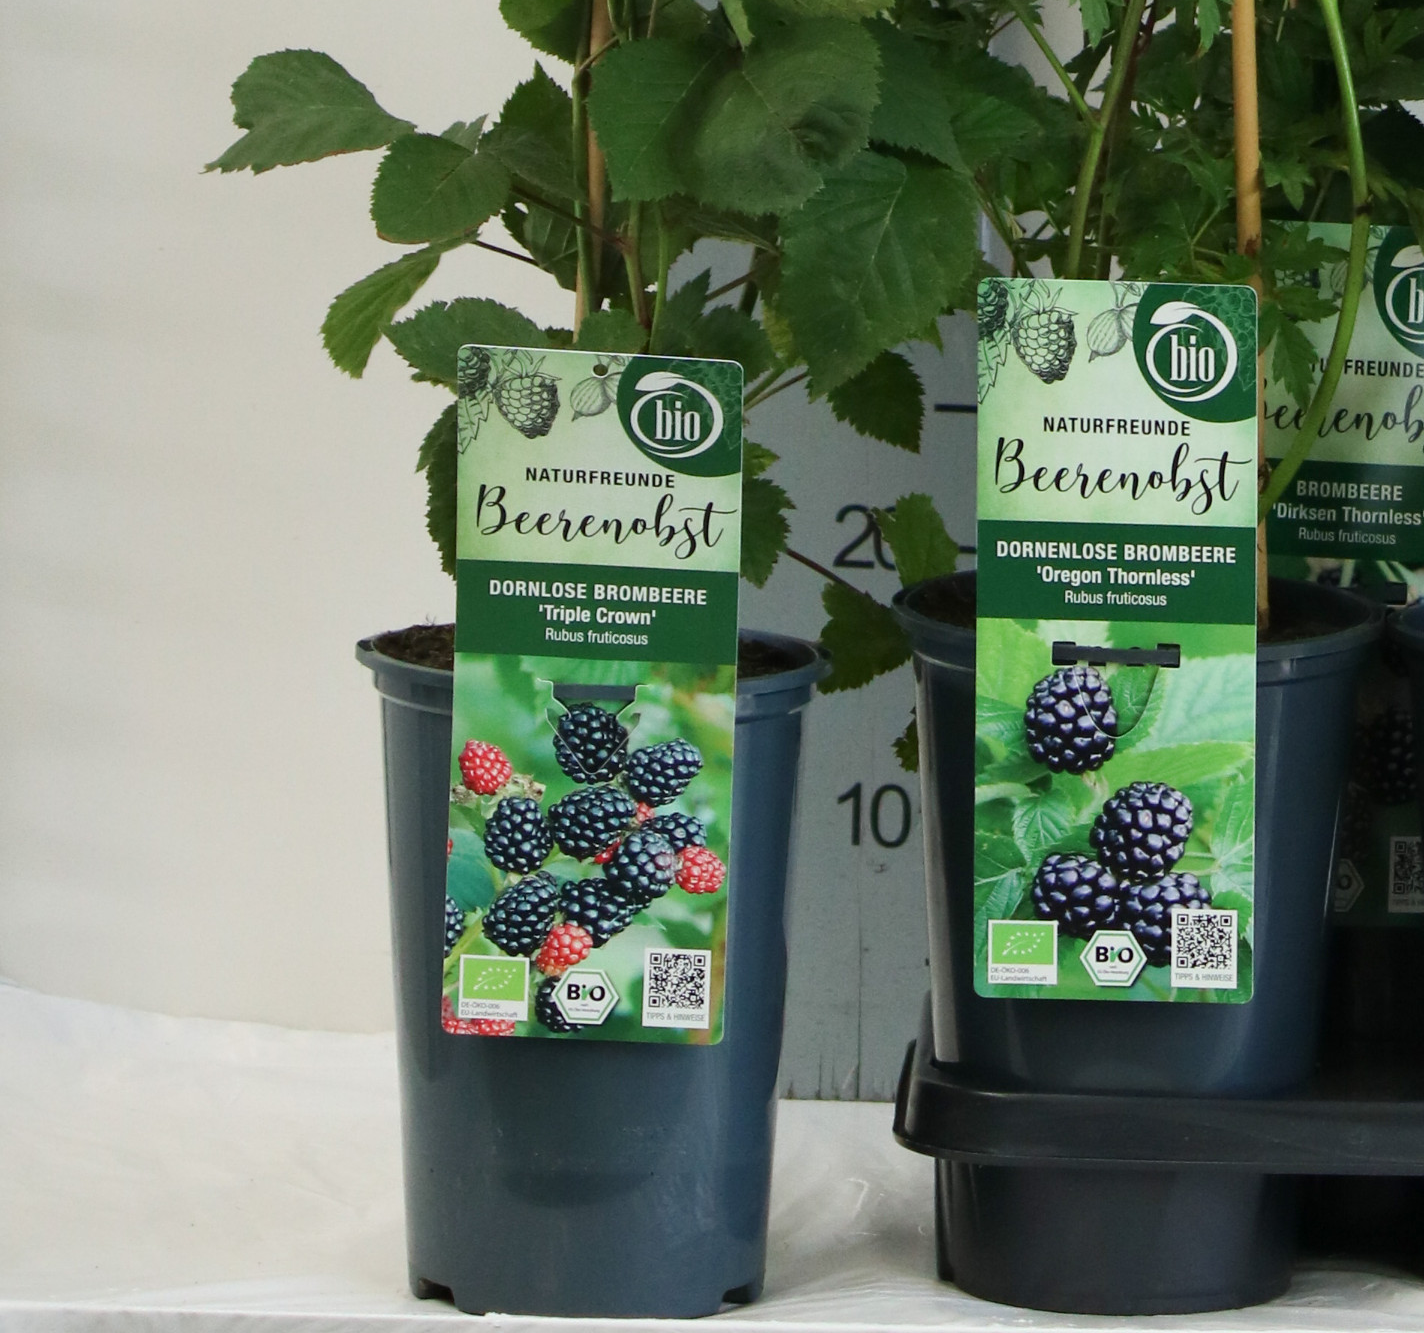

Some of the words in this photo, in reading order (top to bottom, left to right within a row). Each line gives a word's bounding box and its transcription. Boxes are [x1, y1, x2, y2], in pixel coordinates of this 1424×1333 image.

[1170, 335, 1215, 382] bio
[655, 399, 700, 441] bio
[1043, 416, 1191, 437] NATURFREUNDE
[525, 467, 676, 489] NATURFREUNDE
[995, 437, 1252, 515] Beerenobst
[1297, 480, 1403, 501] BROMBEERE
[476, 484, 738, 559] Beerenobst
[1272, 503, 1336, 522] 'Dirksen
[1299, 527, 1334, 542] Rubus
[1338, 528, 1396, 545] fruticosus
[996, 541, 1117, 560] DORNENLOSE
[1124, 545, 1236, 563] BROMBEERE
[1036, 565, 1101, 587] 'Oregon
[1107, 567, 1195, 586] Thornless'
[489, 579, 587, 599] DORNLOSE
[593, 584, 707, 605] BROMBEERE
[1064, 590, 1103, 605] Rubus
[1107, 590, 1167, 606] fruticosus
[539, 604, 591, 624] 'Triple
[596, 607, 656, 626] Crown'
[545, 628, 584, 643] Rubus
[588, 630, 649, 646] fruticosus
[836, 782, 911, 849] 10
[1175, 973, 1193, 981] TIPPS
[1202, 973, 1233, 982] HINWEISE
[646, 1012, 664, 1020] TIPPS
[674, 1013, 705, 1022] HINWEISE
